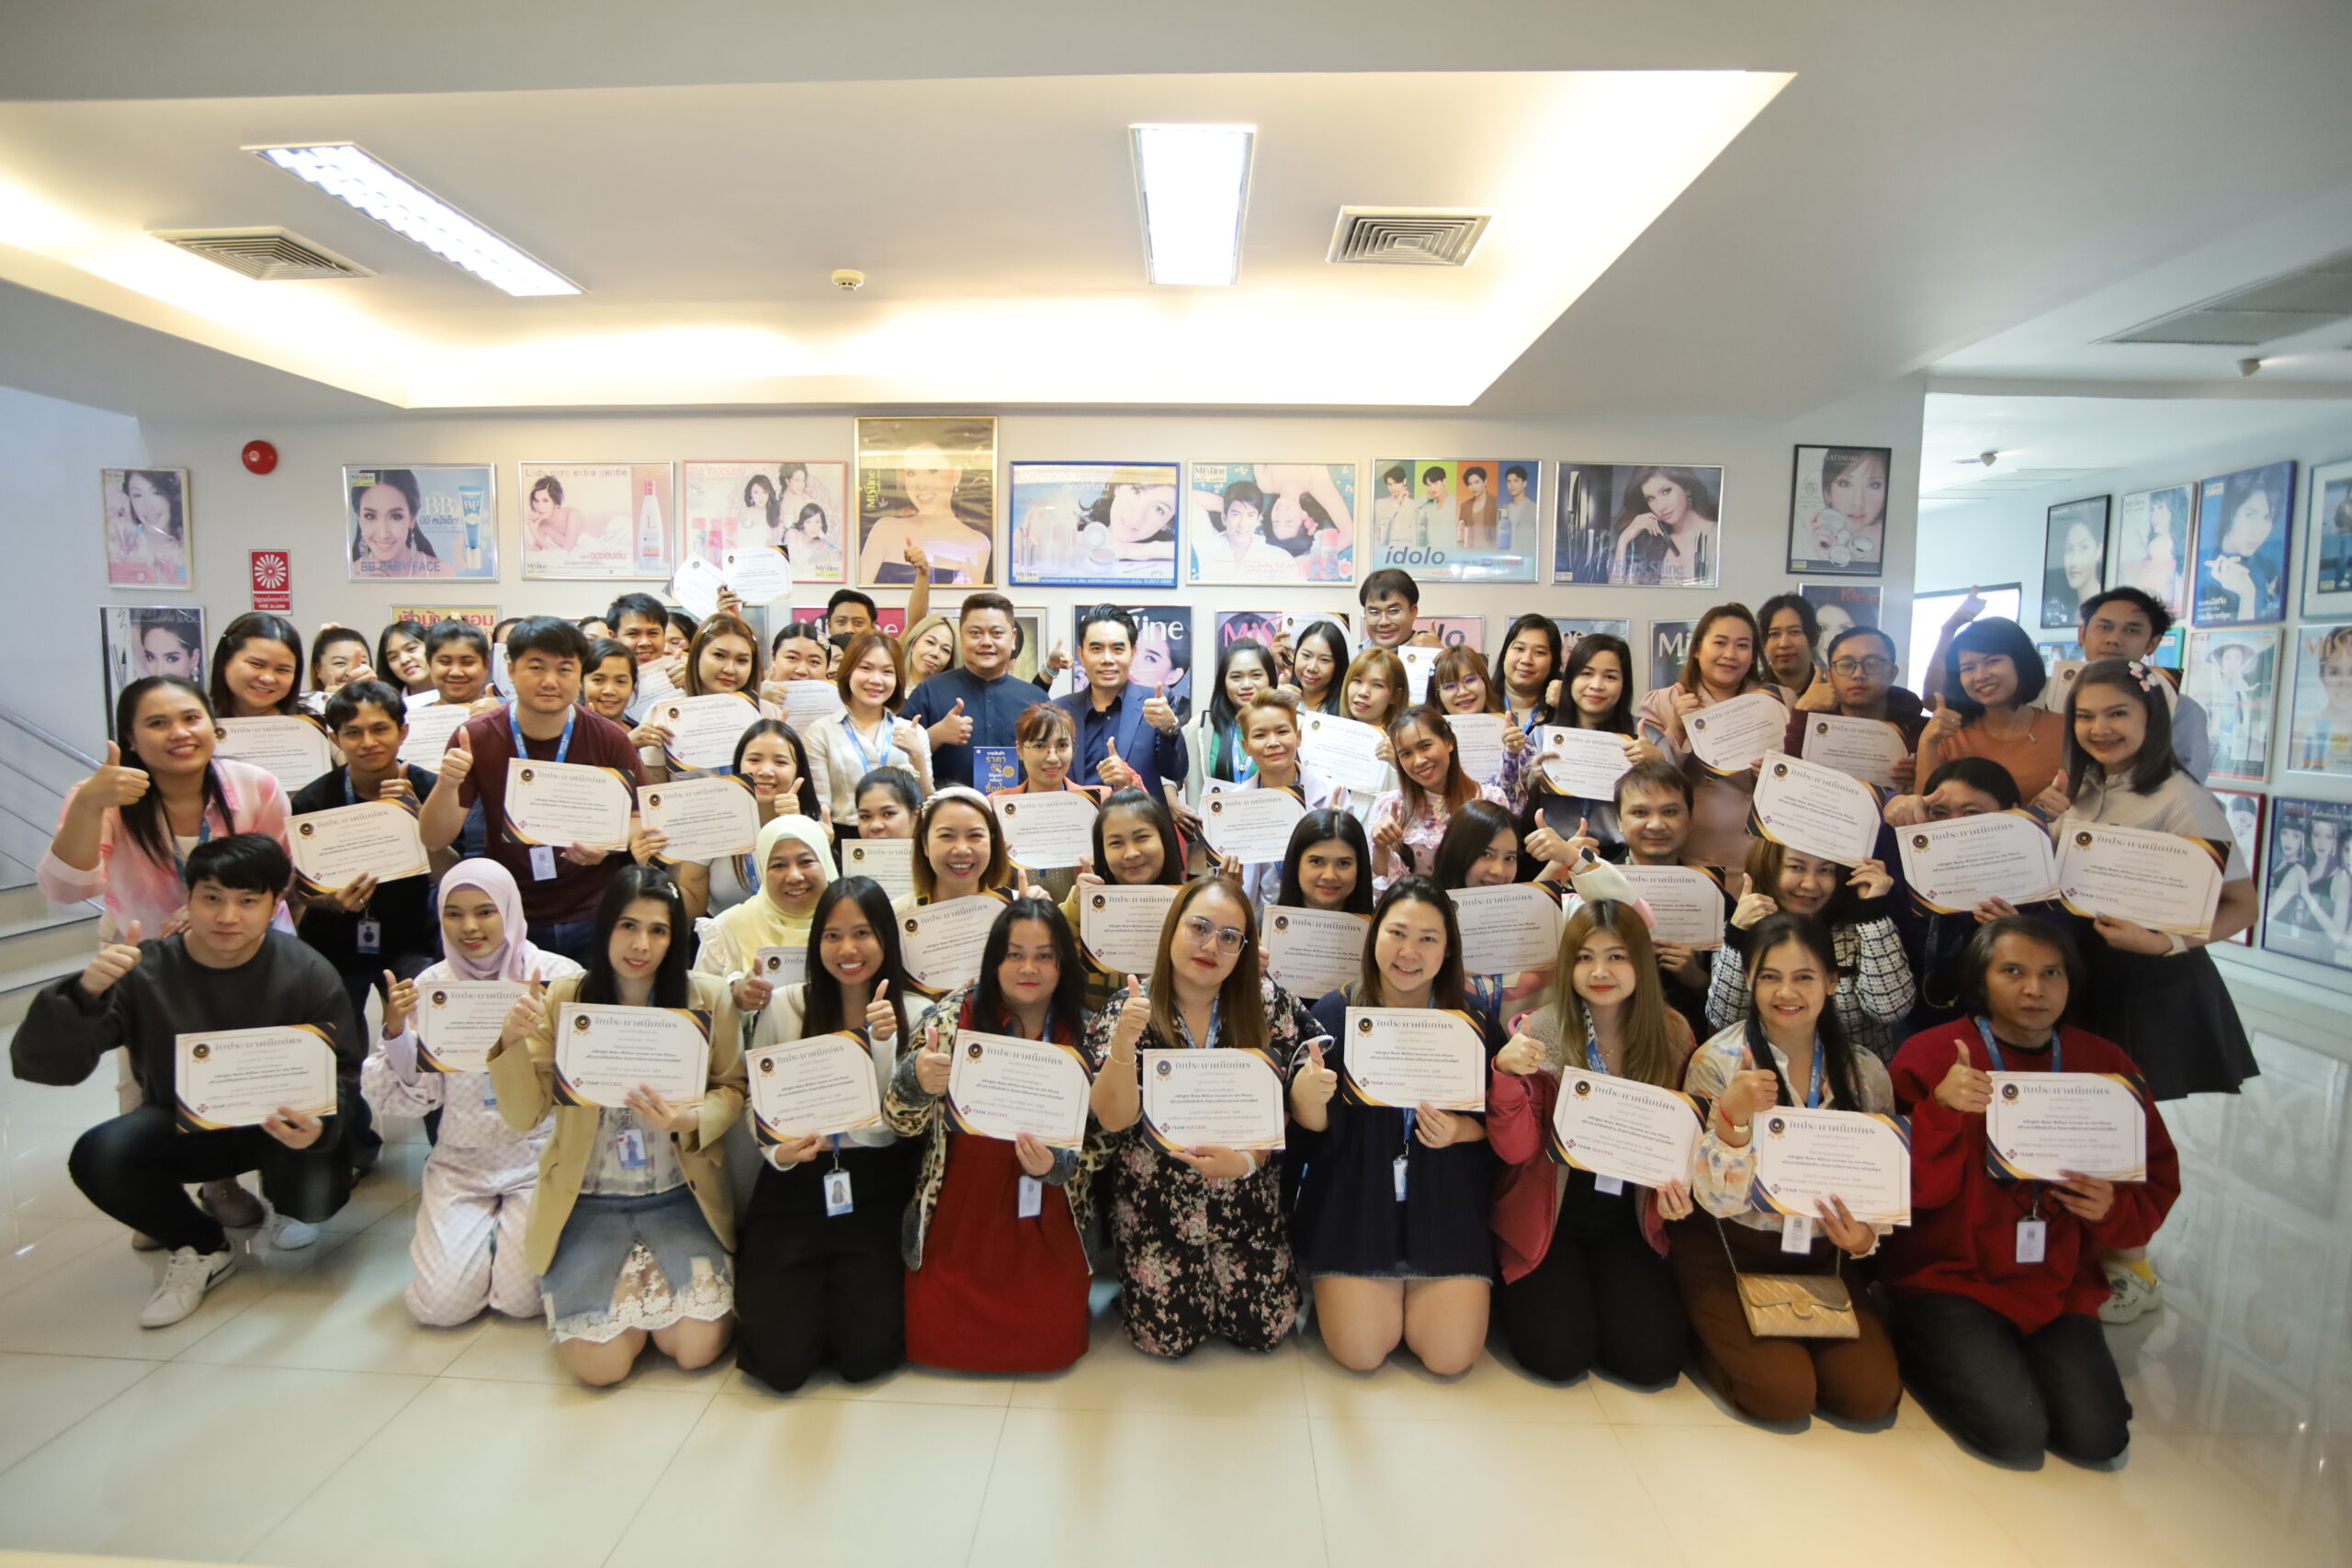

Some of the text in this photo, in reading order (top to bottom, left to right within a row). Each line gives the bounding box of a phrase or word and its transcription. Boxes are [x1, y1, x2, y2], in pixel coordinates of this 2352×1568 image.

[413, 561, 441, 571] FACE
[1931, 823, 2014, 841] ใบประกาศนียบัตร
[2097, 835, 2188, 856] ใบประกาศนียบัตร
[1292, 919, 1362, 931] ใบประกาศนียบัตร
[594, 1016, 679, 1029] ใบประกาศนียบัตร
[1376, 1019, 1453, 1030] ใบประกาศนียบัตร
[987, 1046, 1063, 1066] ใบประกาศนียบัตร
[1175, 1060, 1251, 1070] ใบประกาศนียบัตร
[2022, 1085, 2110, 1095] ใบประกาศนียบัตร
[1594, 1085, 1676, 1111] ใบประกาศนียบัตร
[987, 1110, 1008, 1118] SUCCESS
[1789, 1120, 1875, 1134] ใบประกาศนียบัตร
[1591, 1146, 1613, 1156] SUCCESS
